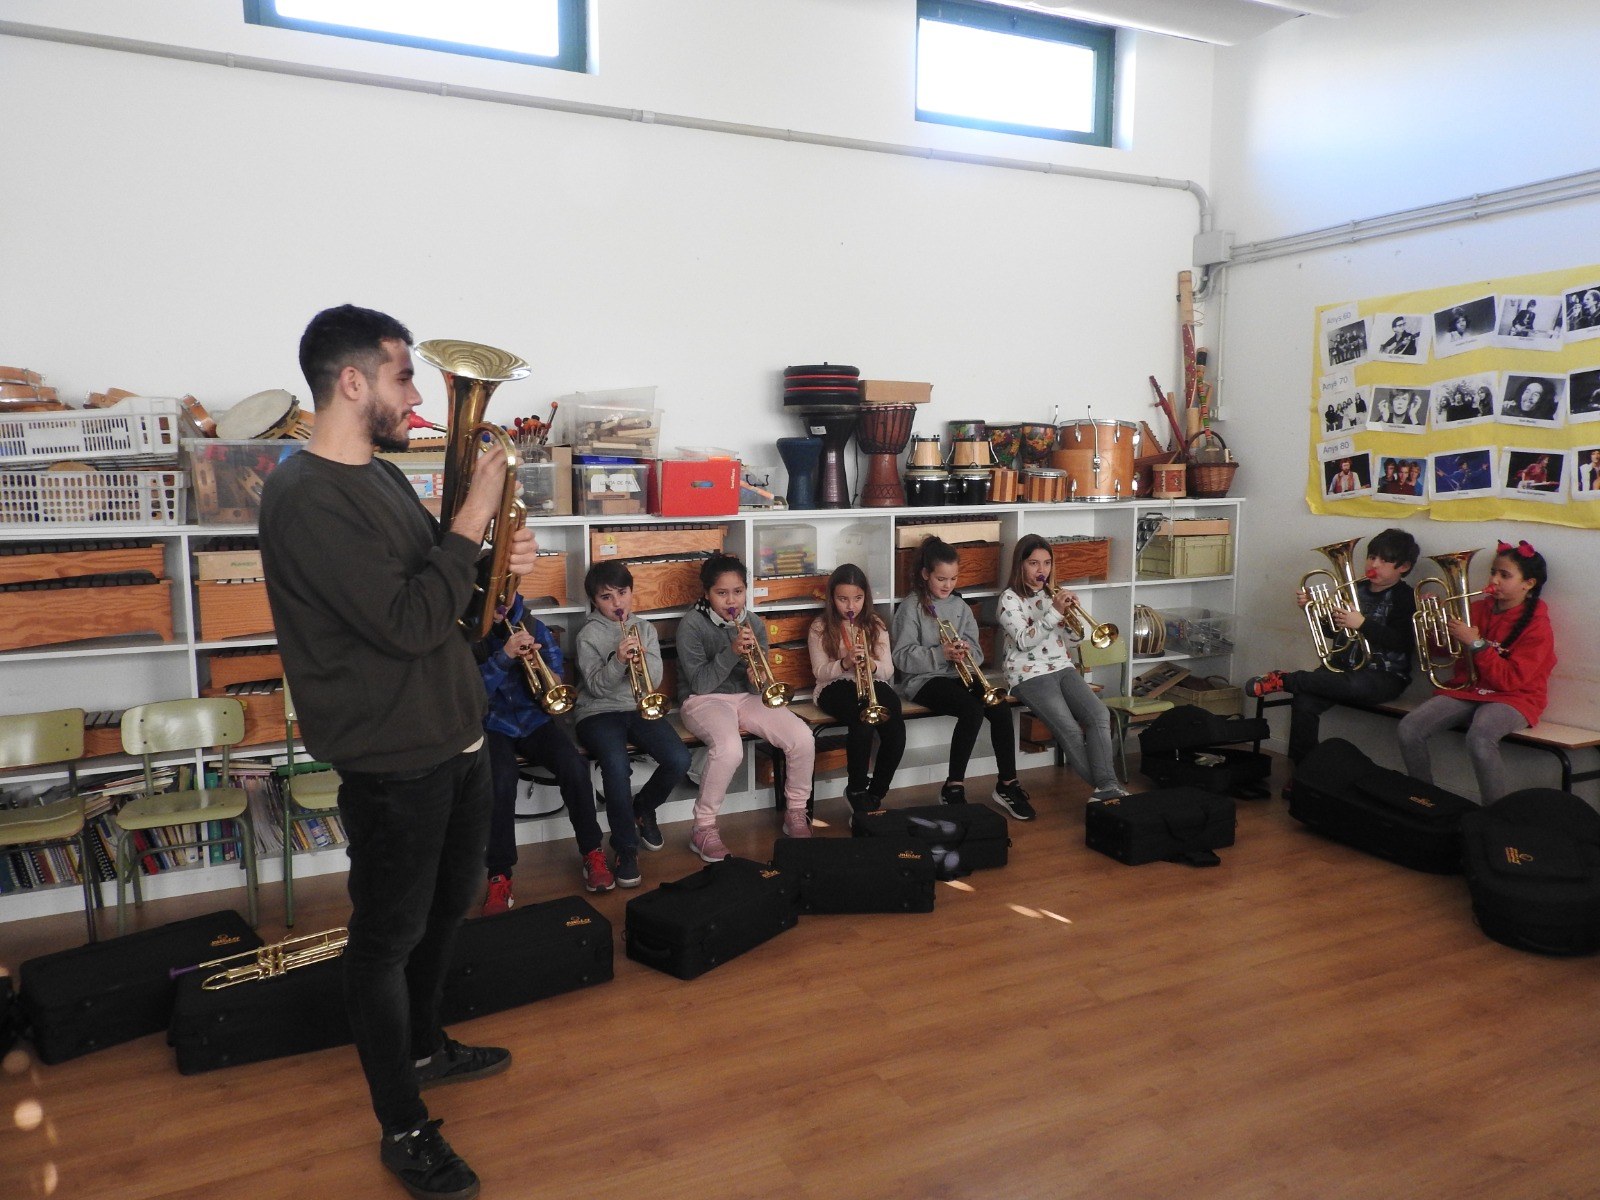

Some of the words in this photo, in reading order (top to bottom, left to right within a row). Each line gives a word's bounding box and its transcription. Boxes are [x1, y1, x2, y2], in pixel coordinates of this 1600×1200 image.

[1321, 380, 1338, 391] Anys
[1339, 375, 1349, 385] 70
[1323, 444, 1339, 454] Anys
[1340, 441, 1350, 450] 80
